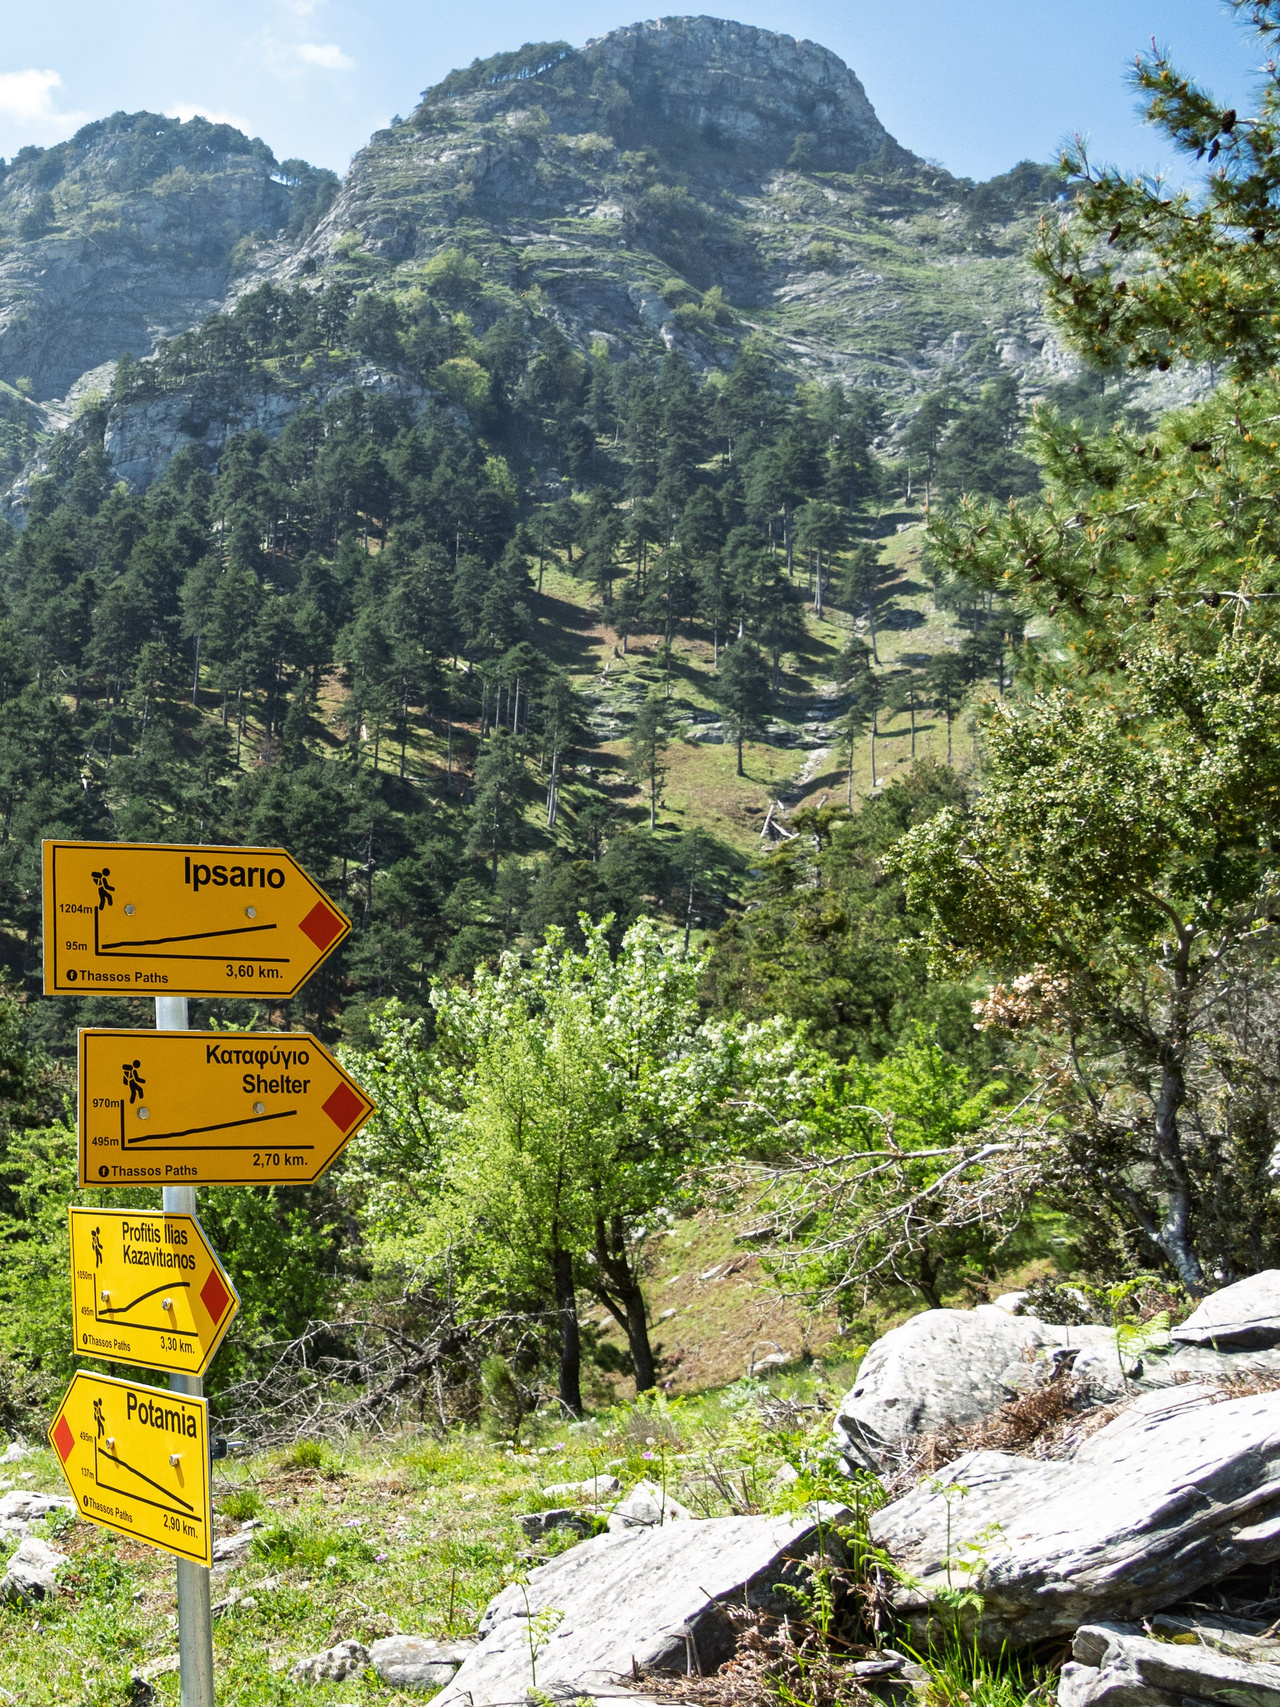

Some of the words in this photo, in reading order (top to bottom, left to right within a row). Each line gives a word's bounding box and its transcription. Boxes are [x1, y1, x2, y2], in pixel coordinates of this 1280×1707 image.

[59, 904, 93, 914] 1204m
[66, 941, 87, 951] 95m
[80, 970, 131, 983] Thassos
[134, 972, 168, 984] Paths
[226, 964, 254, 979] 3,60
[258, 966, 283, 978] km.
[206, 1045, 309, 1069] Καταφύγιο
[243, 1074, 310, 1094] Shelter
[92, 1099, 120, 1108] 970m
[91, 1137, 119, 1146] 495m
[253, 1153, 280, 1167] 2,70
[285, 1154, 307, 1166] km.
[111, 1166, 161, 1177] Thassos
[165, 1165, 197, 1176] Paths
[122, 1222, 160, 1243] Profitis
[164, 1224, 188, 1245] Ilias
[77, 1270, 92, 1280] 1050m
[81, 1307, 94, 1316] 495m
[88, 1334, 112, 1349] Thassos
[114, 1339, 130, 1352] Paths
[161, 1336, 177, 1352] 3,30
[180, 1338, 195, 1354] km.
[127, 1392, 197, 1438] Potamia
[80, 1431, 93, 1442] 495m
[81, 1467, 94, 1479] 137m
[89, 1497, 114, 1516] Thassos
[115, 1507, 133, 1523] Paths
[163, 1514, 180, 1532] 2,90
[183, 1520, 198, 1539] km.
